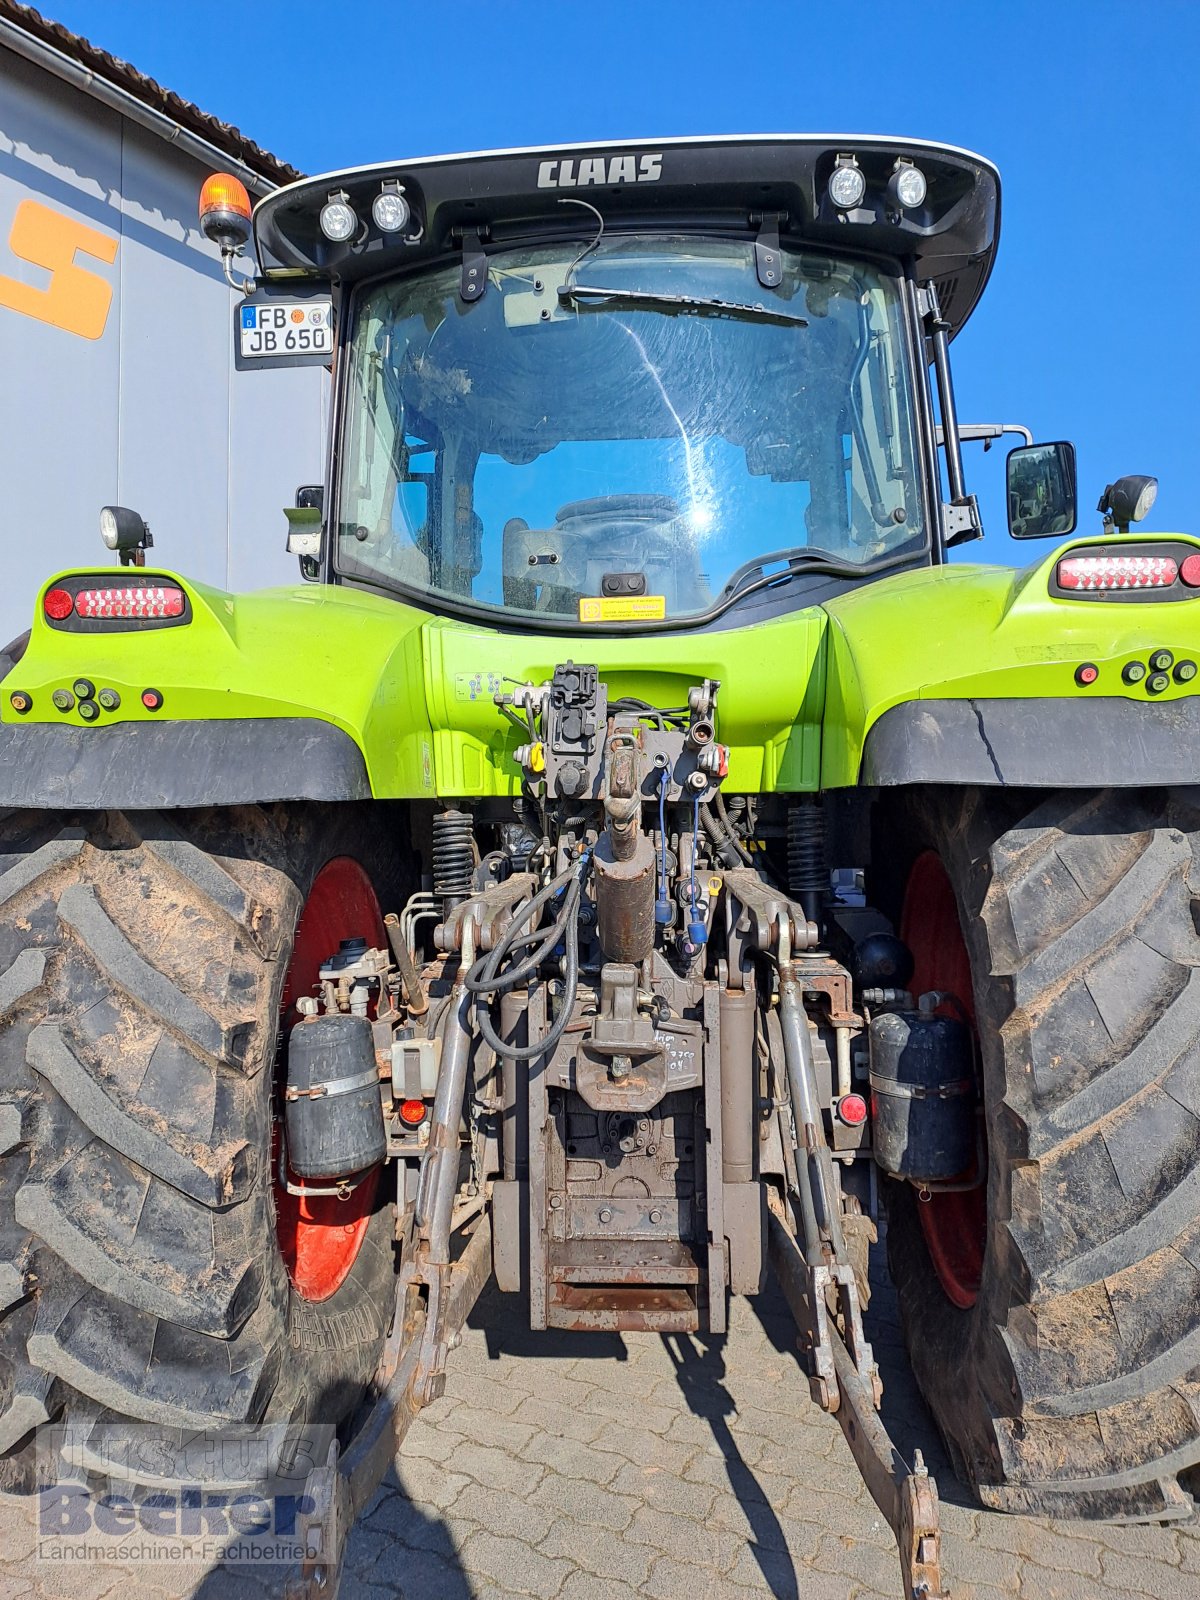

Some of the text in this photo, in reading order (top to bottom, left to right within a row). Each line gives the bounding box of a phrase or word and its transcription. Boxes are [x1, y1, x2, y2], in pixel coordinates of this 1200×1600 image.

[537, 153, 663, 188] CLAAS
[259, 308, 287, 329] FB
[250, 328, 325, 352] JB 650
